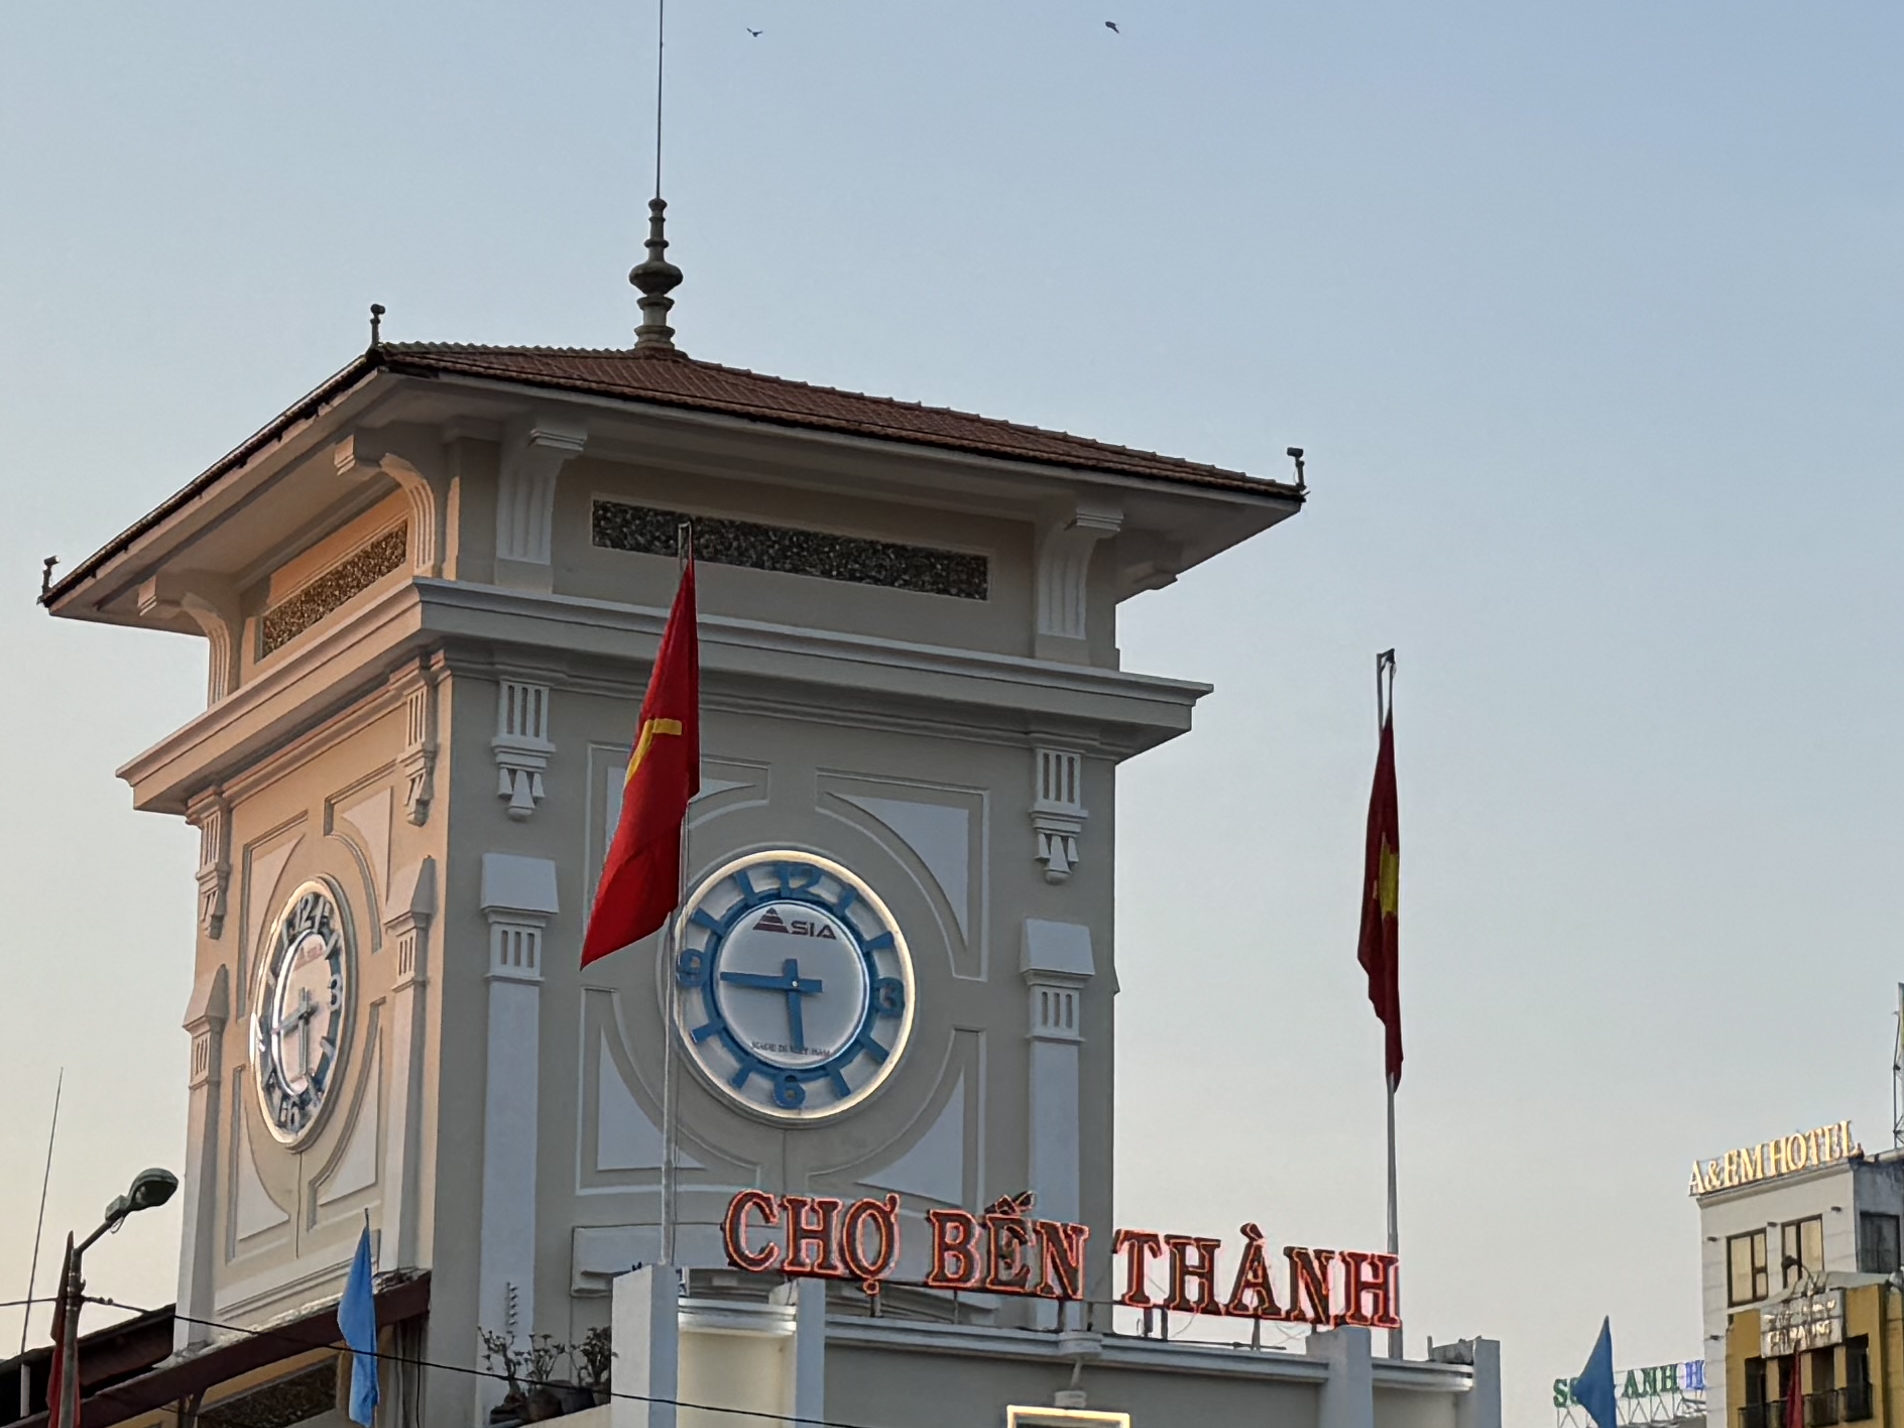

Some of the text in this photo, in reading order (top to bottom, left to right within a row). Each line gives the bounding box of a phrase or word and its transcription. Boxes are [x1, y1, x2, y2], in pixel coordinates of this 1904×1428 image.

[1768, 1120, 1858, 1177] HOTEL
[723, 1188, 1401, 1329] CHỢ BẾN THÀNH
